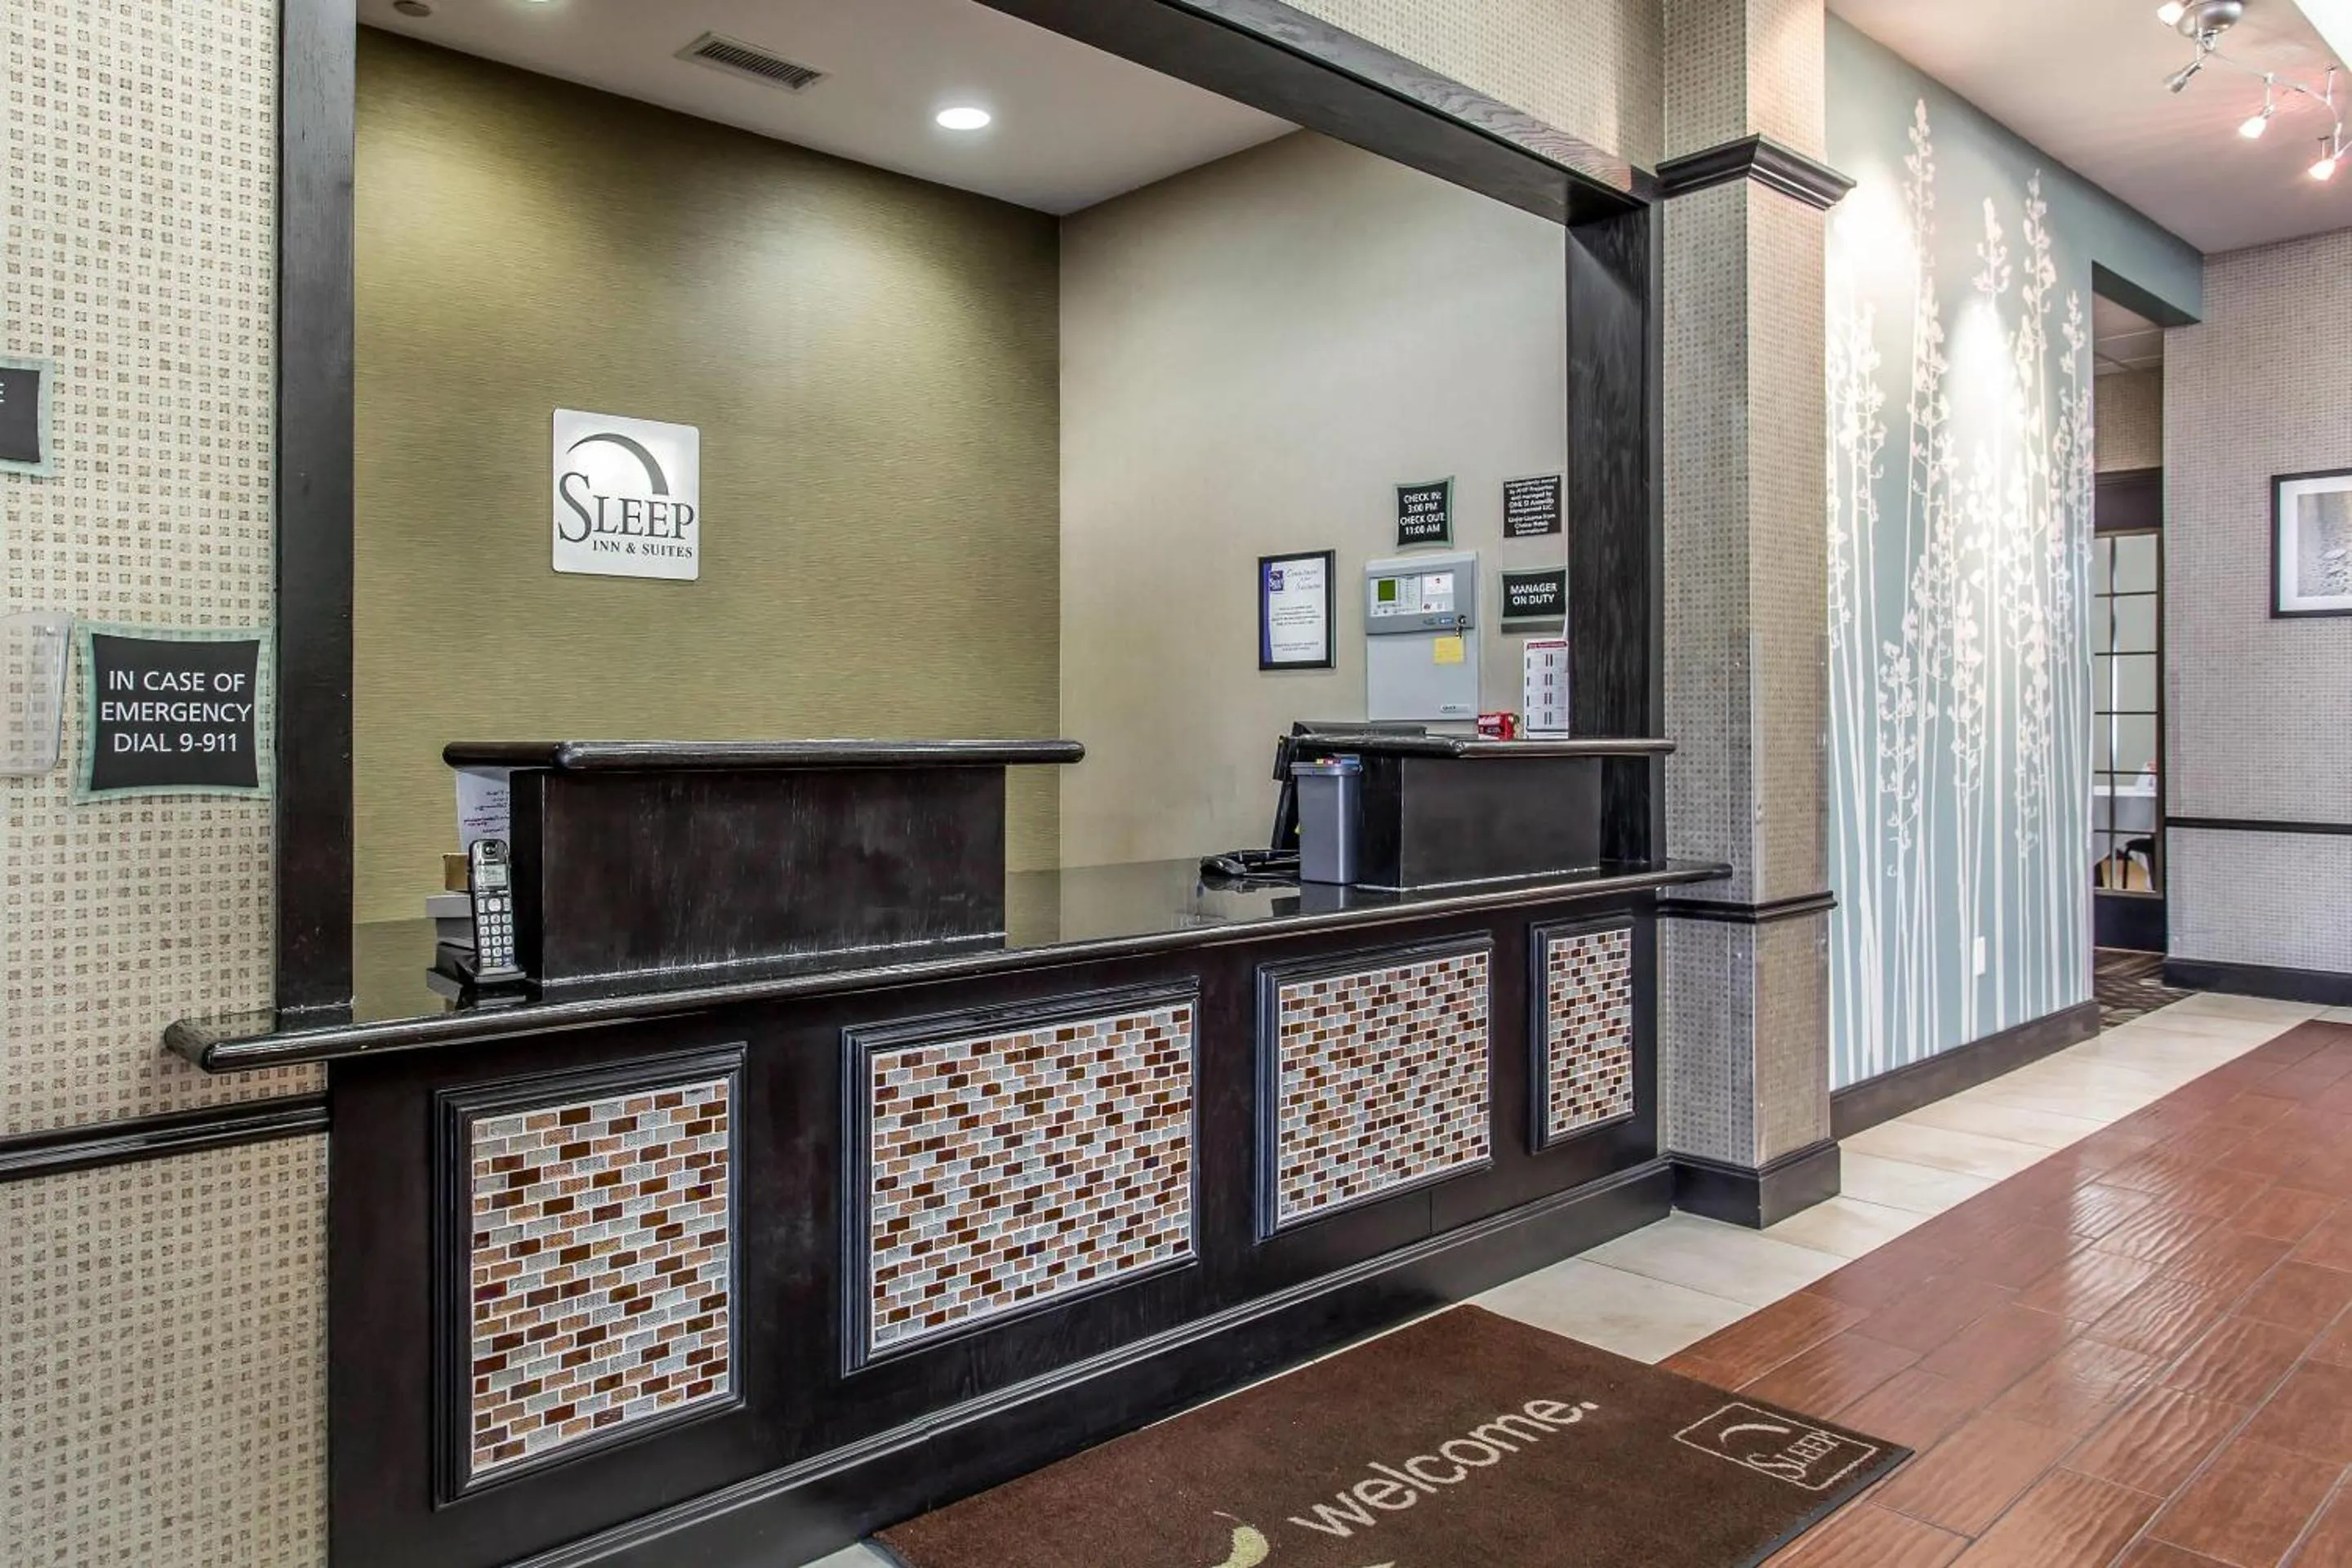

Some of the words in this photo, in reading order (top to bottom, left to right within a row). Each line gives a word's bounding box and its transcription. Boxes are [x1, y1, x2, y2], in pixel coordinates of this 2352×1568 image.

[1404, 492, 1429, 504] CHECK
[1425, 501, 1437, 511] PM
[558, 471, 694, 543] SLEEP
[1400, 514, 1426, 526] CHECK
[1426, 523, 1441, 533] AM
[593, 540, 621, 552] INN
[626, 543, 636, 555] &
[642, 543, 693, 559] SUITES
[1510, 582, 1557, 595] MANAGER
[1512, 595, 1527, 605] ON
[1529, 594, 1555, 604] DUTY
[109, 670, 134, 691] IN
[143, 671, 205, 692] CASE
[213, 672, 246, 693] OF
[101, 702, 252, 723] EMERGENCY
[114, 733, 172, 752] DIAL
[179, 733, 237, 752] 9-911
[1286, 1399, 1600, 1538] welcome.
